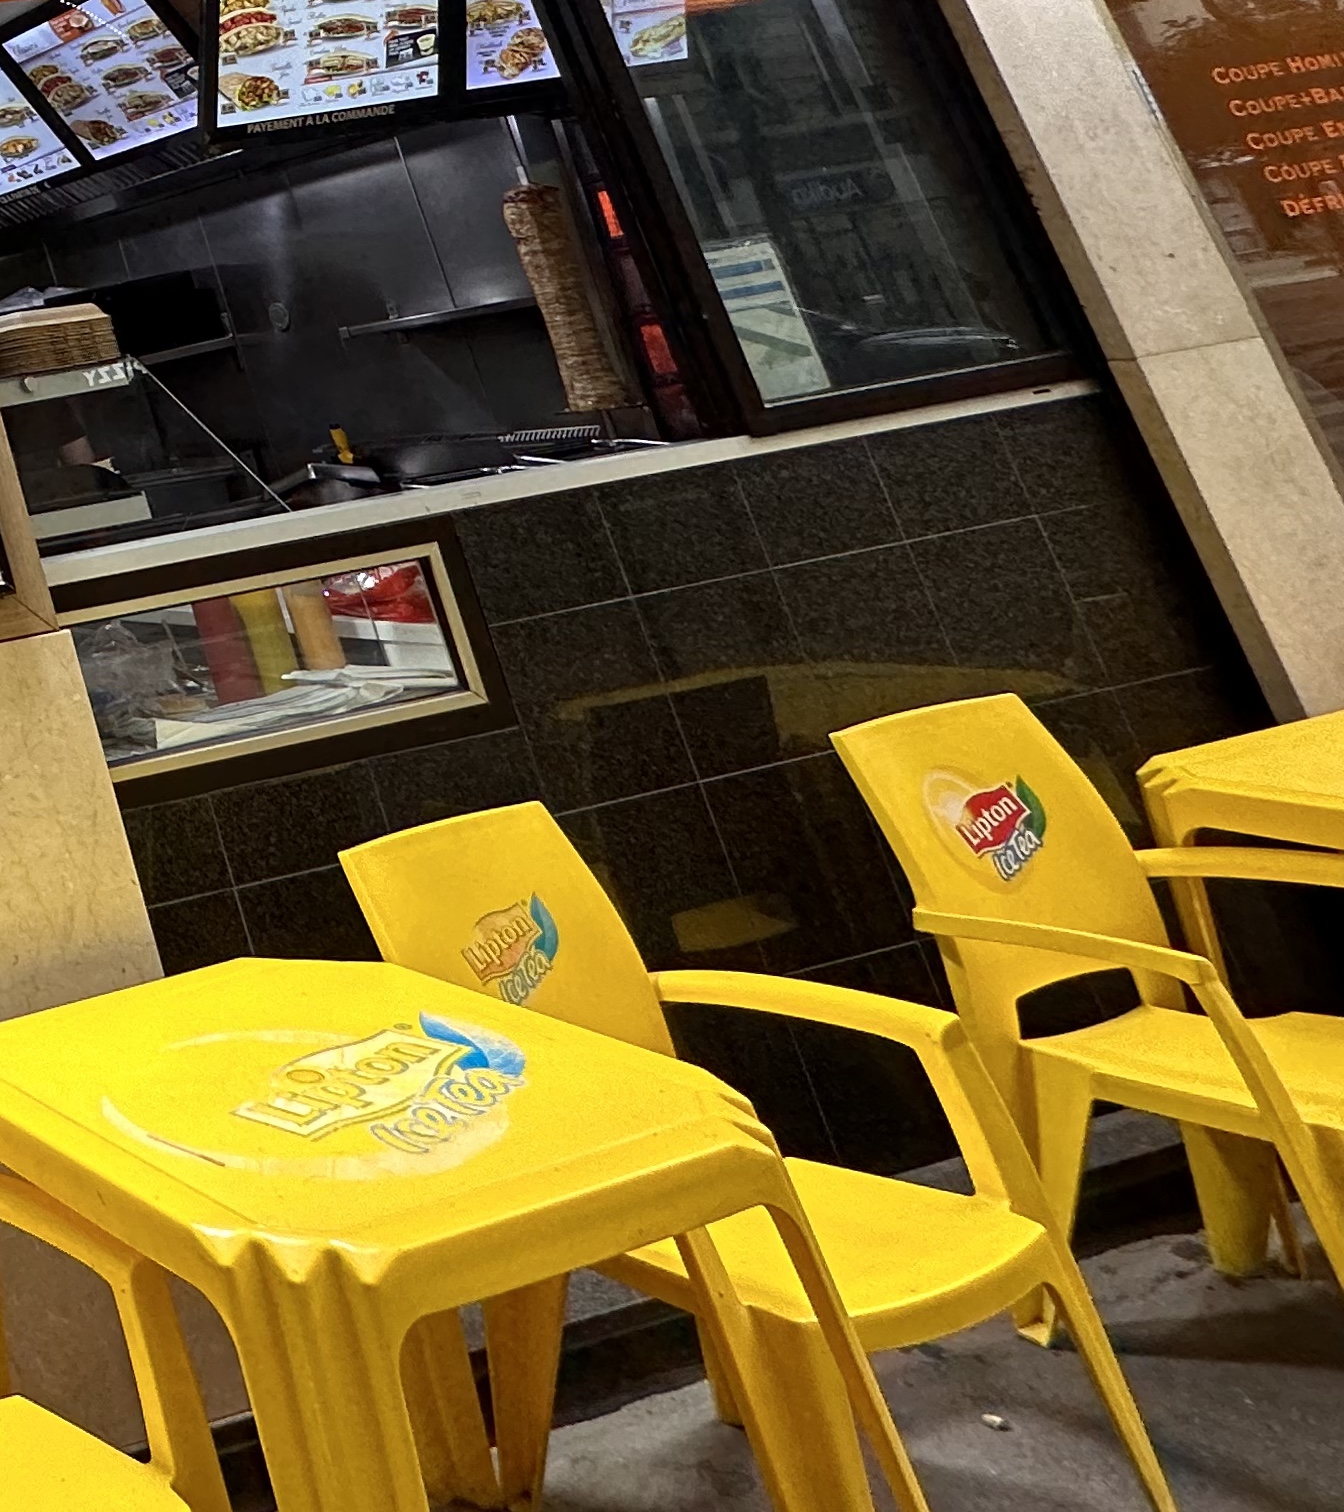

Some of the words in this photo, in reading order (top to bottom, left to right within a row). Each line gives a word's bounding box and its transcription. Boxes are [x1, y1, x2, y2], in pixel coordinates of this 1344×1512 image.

[1212, 61, 1286, 84] COUPE
[247, 117, 305, 134] PAYEMENT
[316, 114, 330, 124] LA
[331, 104, 395, 123] COMMANDE
[1246, 125, 1319, 150] COUPE
[1264, 159, 1339, 183] COUPE
[961, 797, 1018, 847] Lipton
[469, 915, 532, 971] Lipton
[249, 1039, 440, 1127] Lipton
